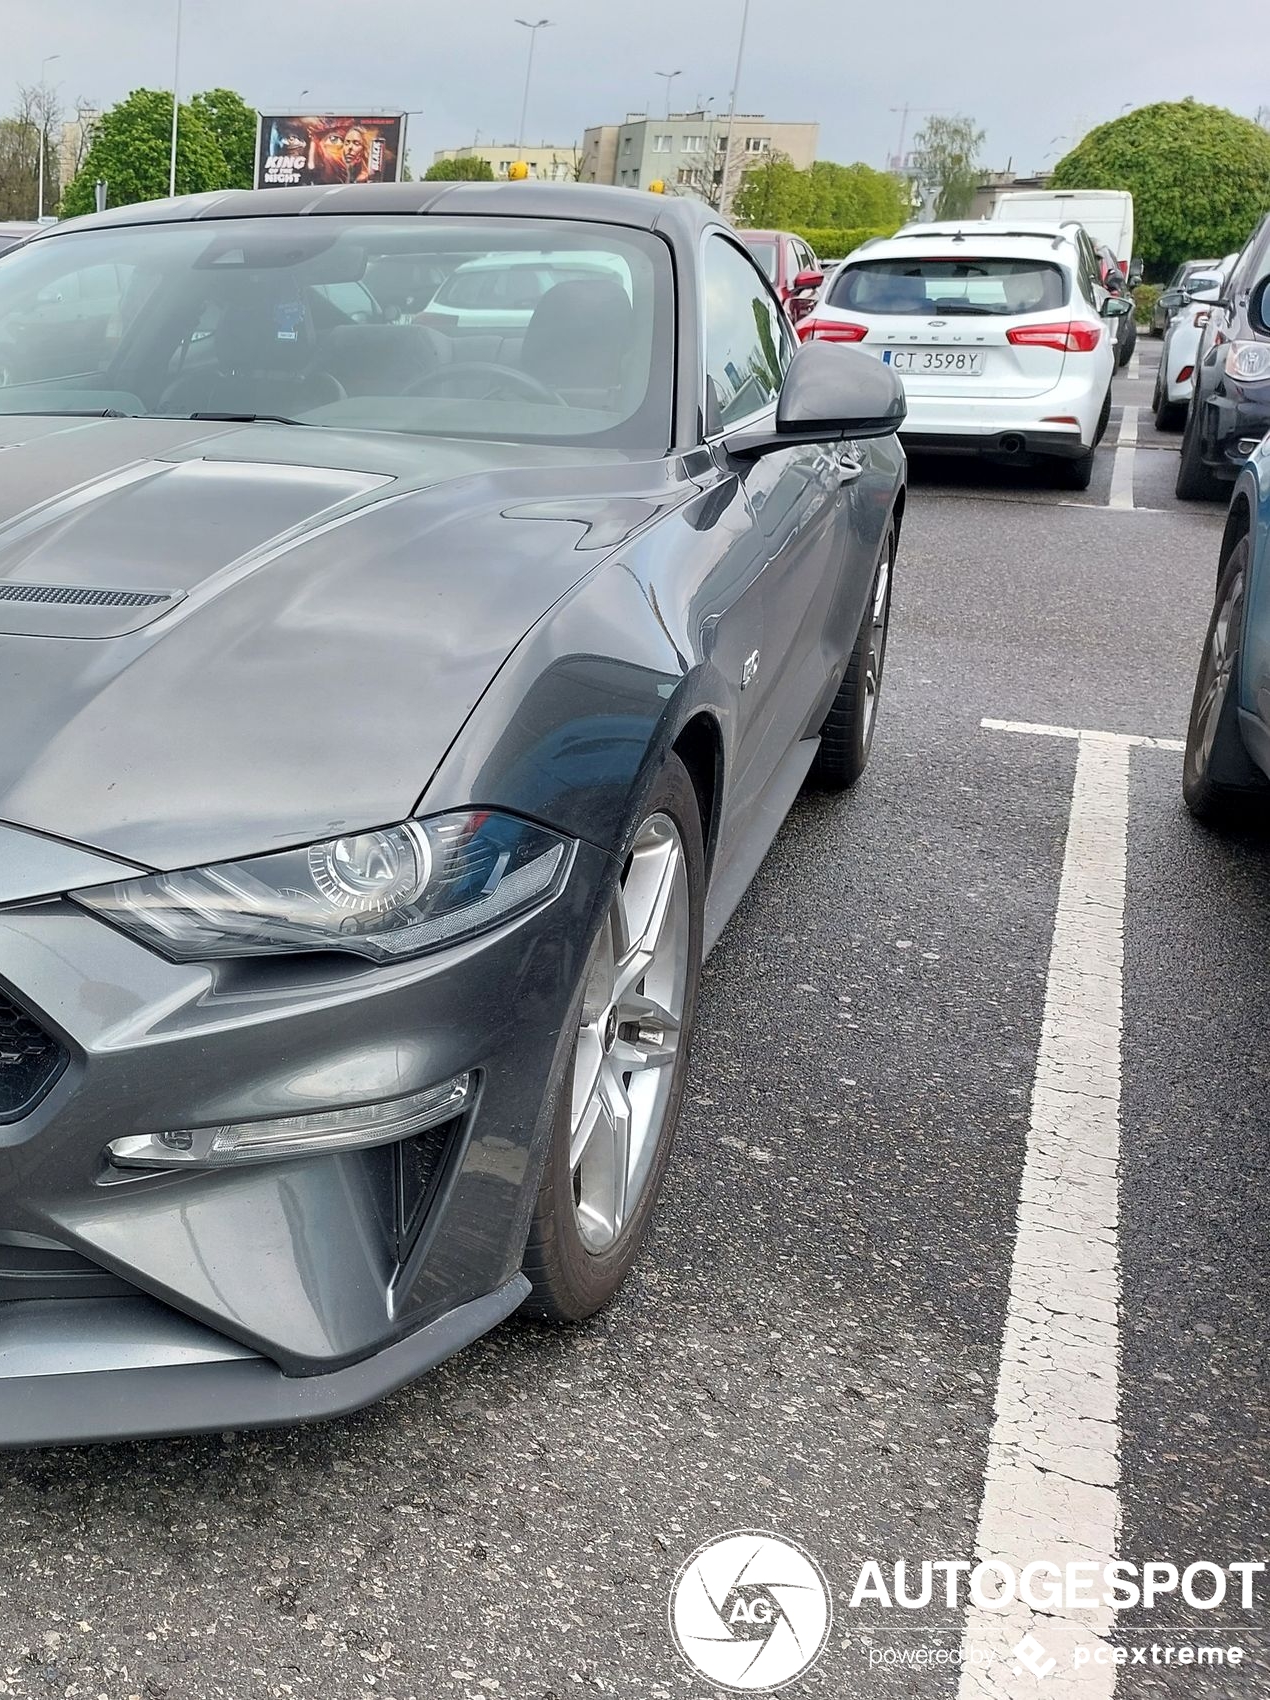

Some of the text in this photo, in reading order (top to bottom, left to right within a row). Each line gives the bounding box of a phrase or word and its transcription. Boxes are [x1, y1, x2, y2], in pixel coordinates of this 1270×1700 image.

[264, 155, 307, 170] KING
[264, 172, 301, 183] NIGHT
[894, 353, 978, 369] CT 3598Y
